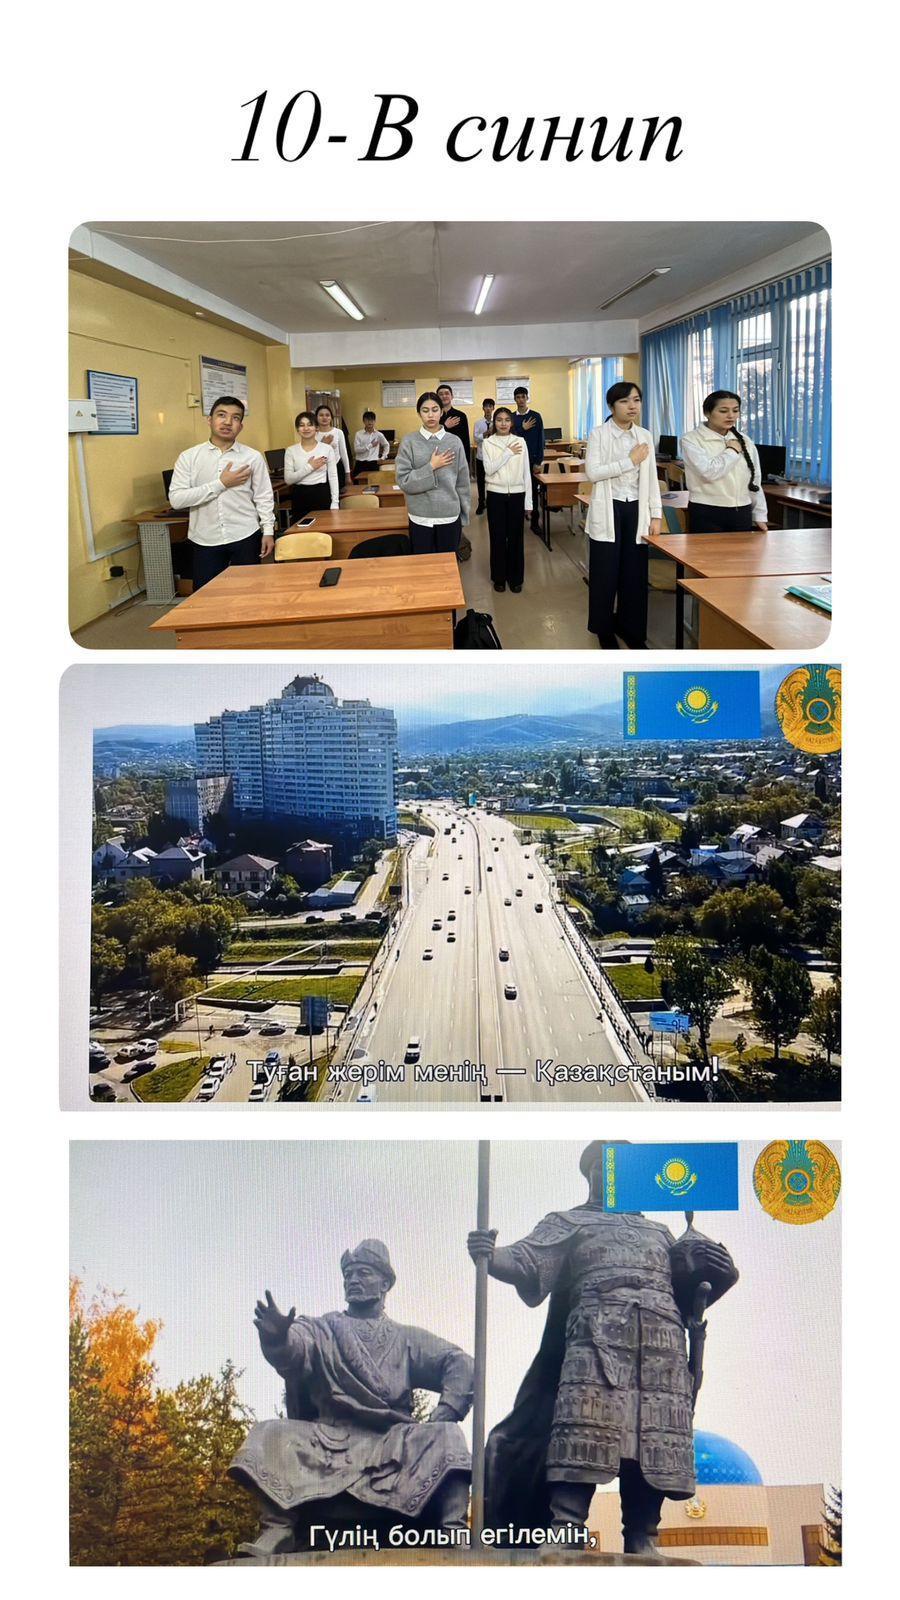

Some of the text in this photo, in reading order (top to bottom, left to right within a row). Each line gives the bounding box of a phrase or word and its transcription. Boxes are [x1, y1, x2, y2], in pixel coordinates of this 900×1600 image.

[246, 1060, 318, 1087] Туған
[327, 1060, 405, 1087] жерім
[414, 1060, 488, 1086] менің
[535, 1056, 719, 1086] Қазақстаным!
[309, 1522, 598, 1552] Гүлің болып егілемін,
